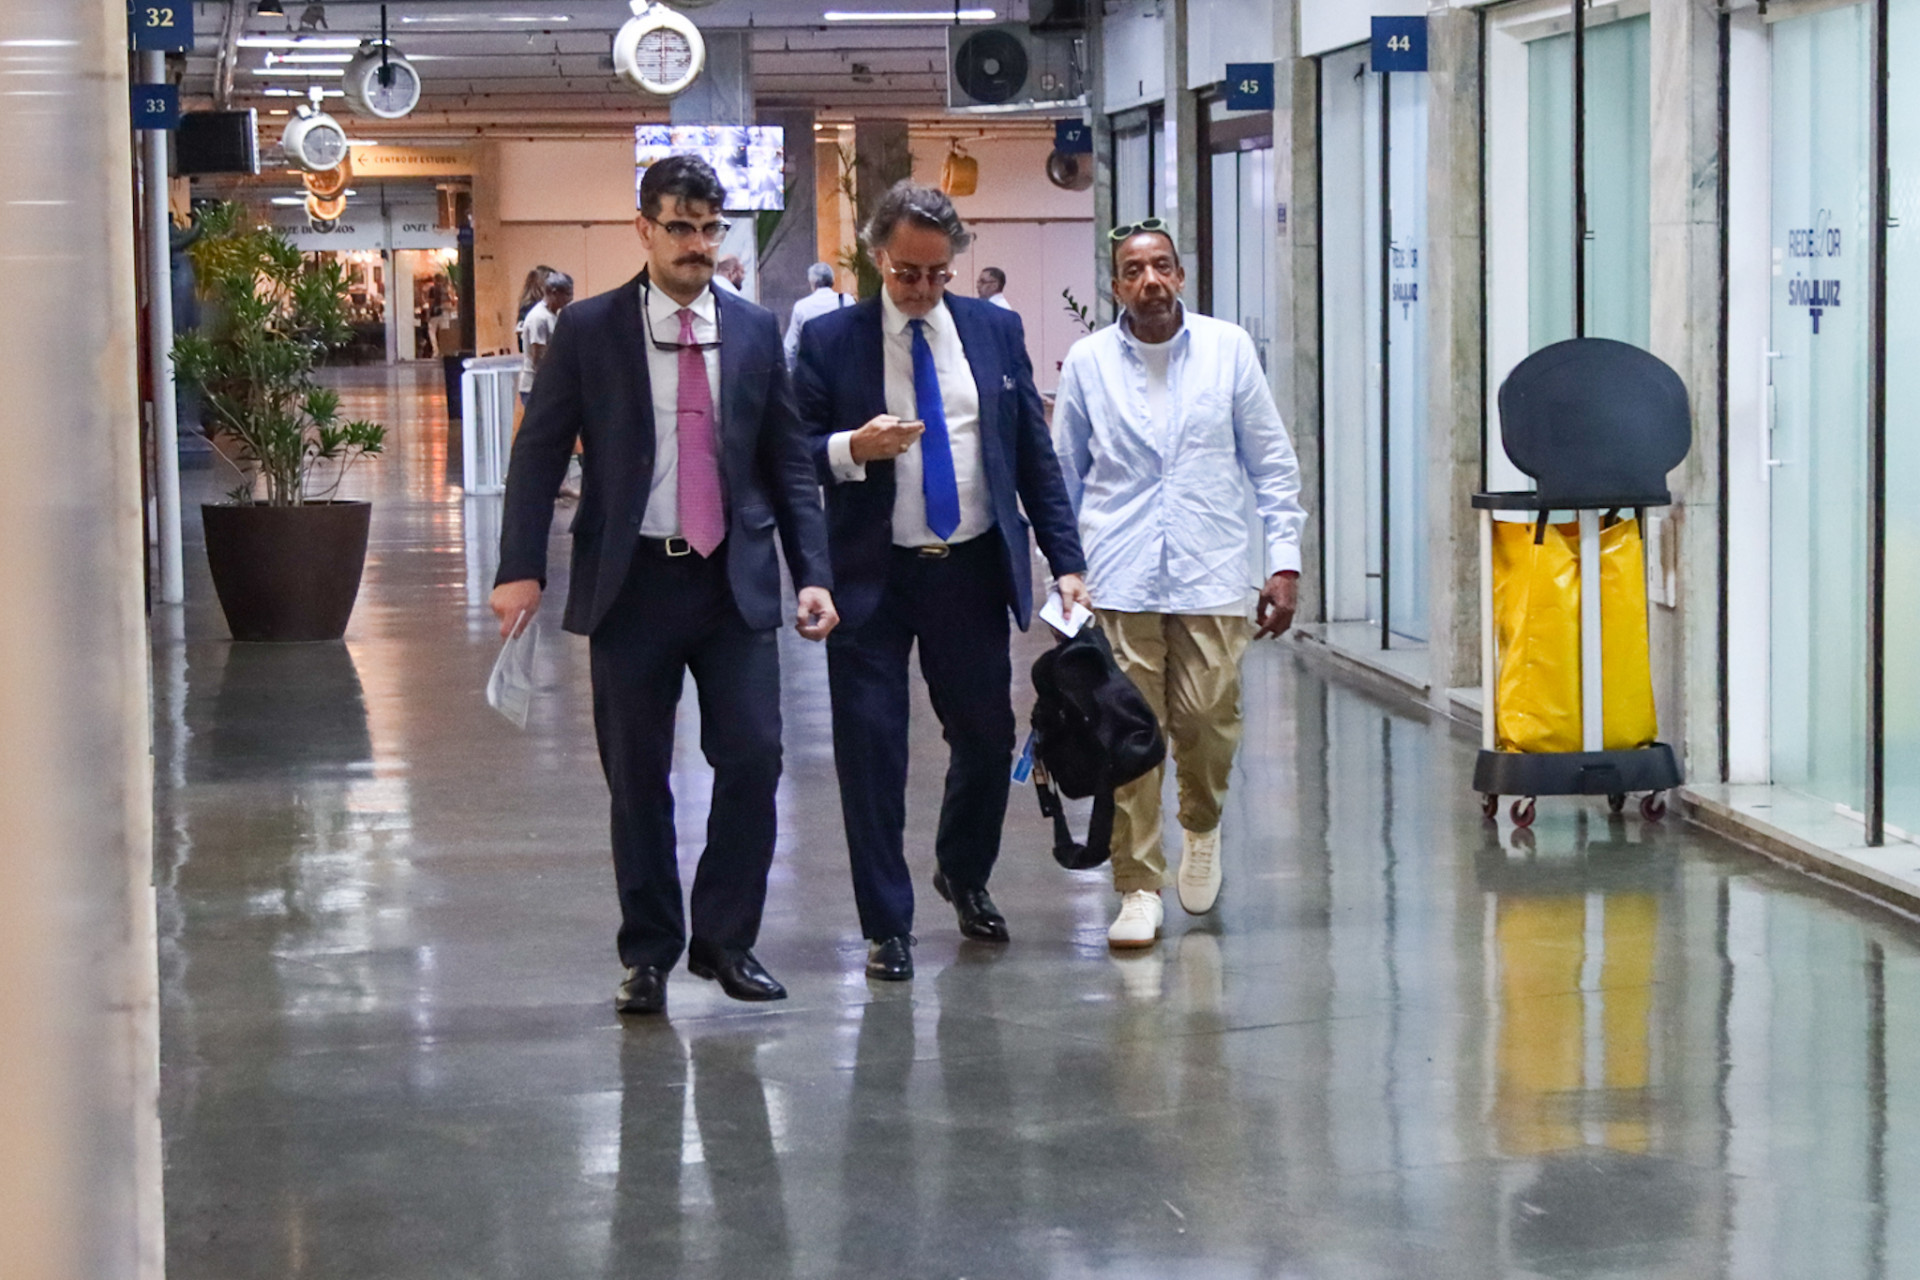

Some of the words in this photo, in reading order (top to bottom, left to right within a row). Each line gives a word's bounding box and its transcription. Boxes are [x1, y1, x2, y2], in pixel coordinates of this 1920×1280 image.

[146, 8, 174, 27] 32
[1387, 35, 1410, 51] 44
[1239, 79, 1259, 94] 45
[146, 98, 166, 113] 33
[1066, 130, 1081, 141] 47
[403, 223, 427, 232] ONZE
[1789, 228, 1814, 257] REDE
